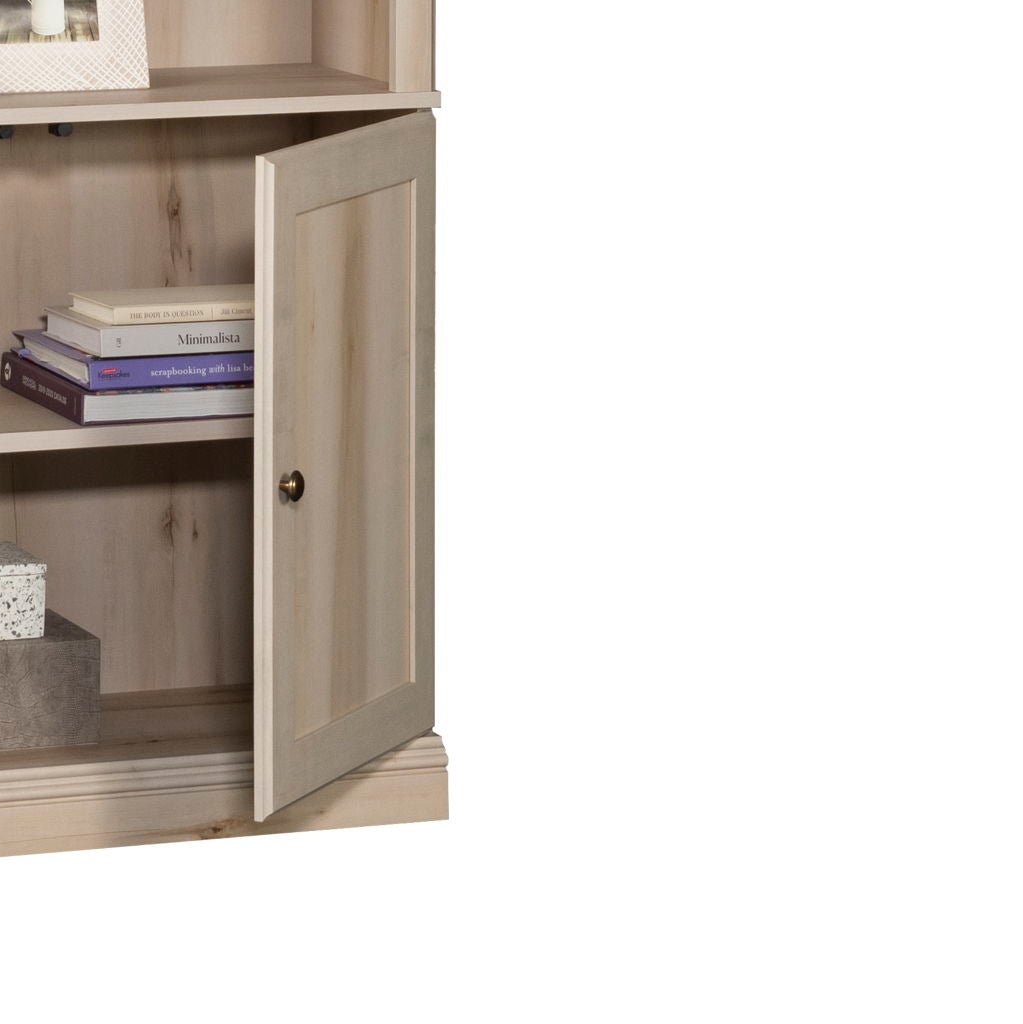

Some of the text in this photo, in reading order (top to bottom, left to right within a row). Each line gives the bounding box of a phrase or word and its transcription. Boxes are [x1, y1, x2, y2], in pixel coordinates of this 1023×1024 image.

[129, 312, 143, 320] THE
[144, 311, 161, 319] BODY
[171, 310, 204, 318] QUESTION
[177, 332, 241, 346] Minimalista
[150, 365, 207, 378] scrapbooking
[208, 363, 225, 374] with
[227, 363, 241, 373] lisa
